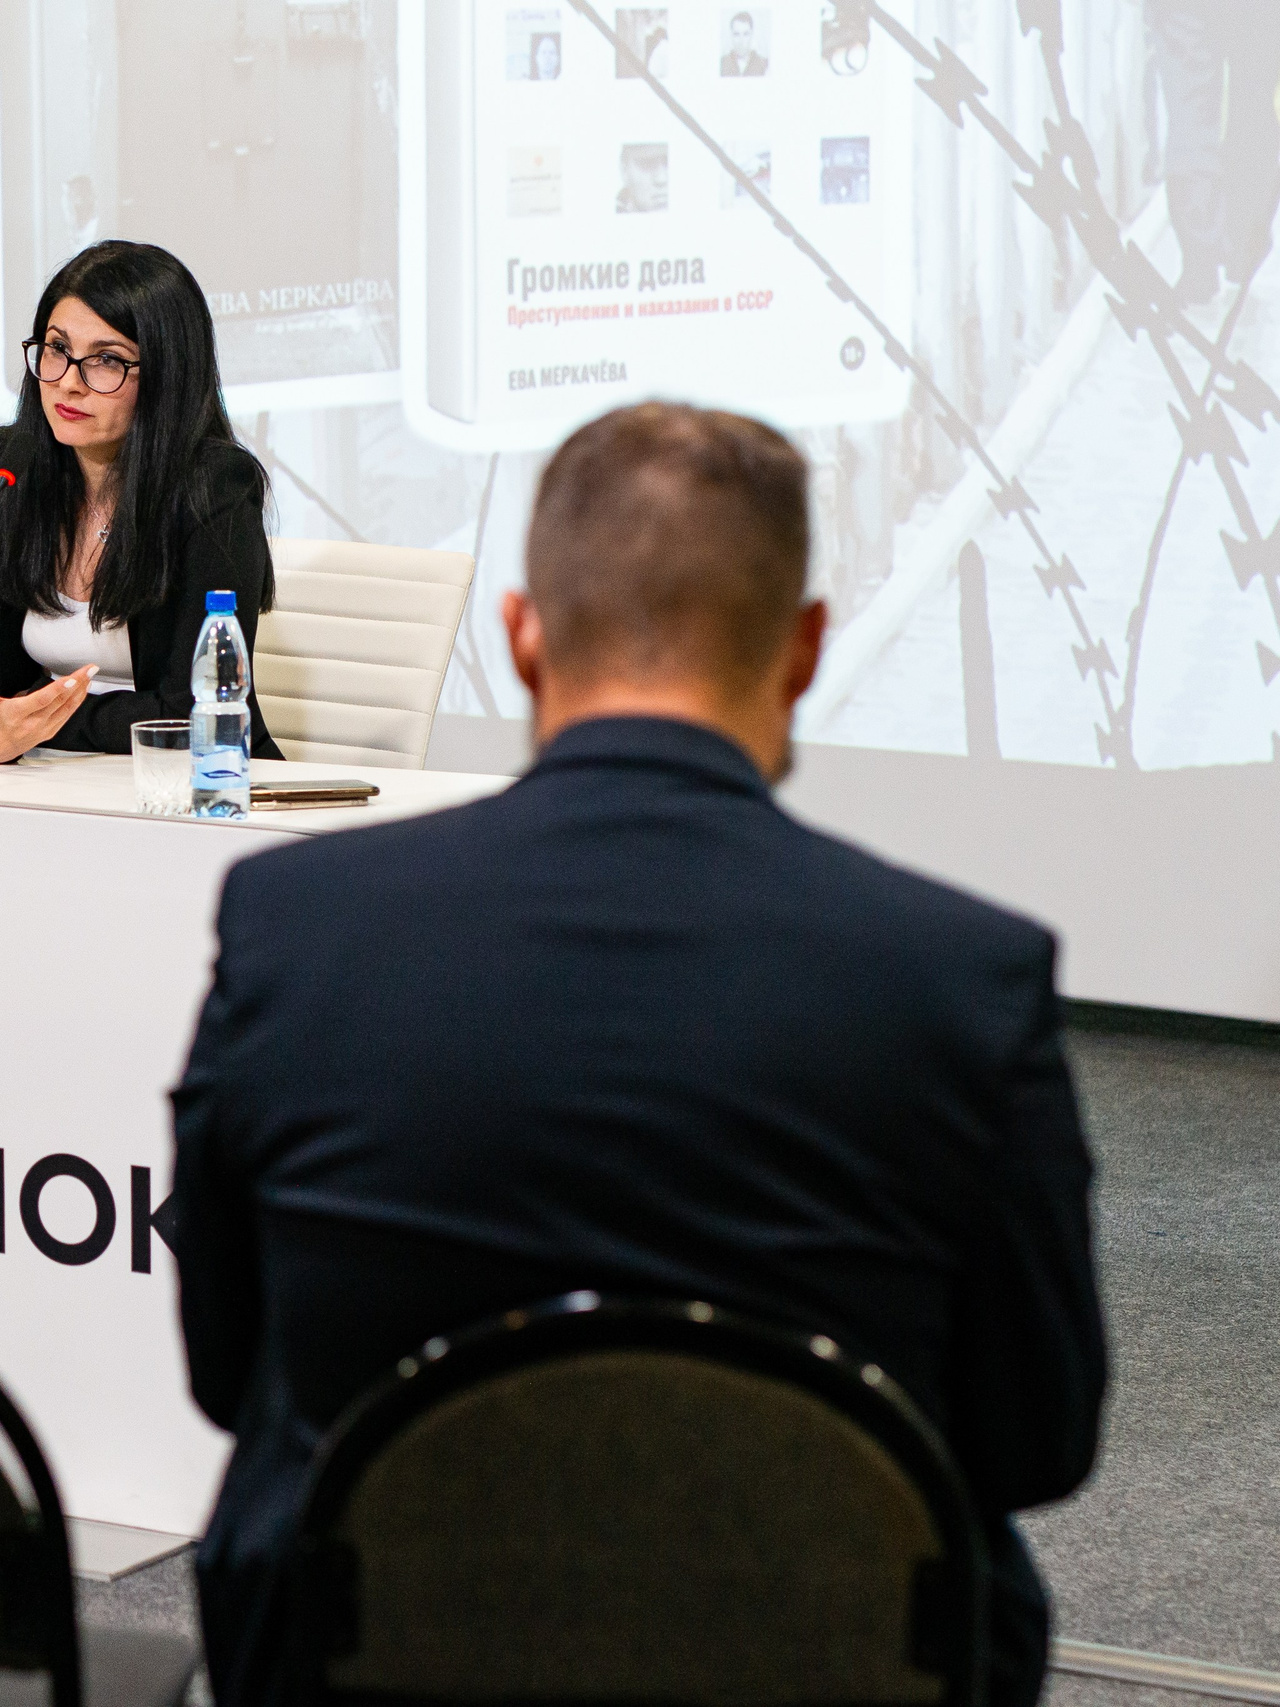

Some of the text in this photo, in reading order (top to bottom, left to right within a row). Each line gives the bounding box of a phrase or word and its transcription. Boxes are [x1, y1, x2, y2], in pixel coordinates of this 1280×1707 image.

[507, 257, 705, 302] Громкие дела
[206, 291, 251, 315] ЕВА
[508, 289, 774, 329] Преступления и наказания в СССР
[508, 359, 627, 391] ЕВА МЕРКАЧЁВА
